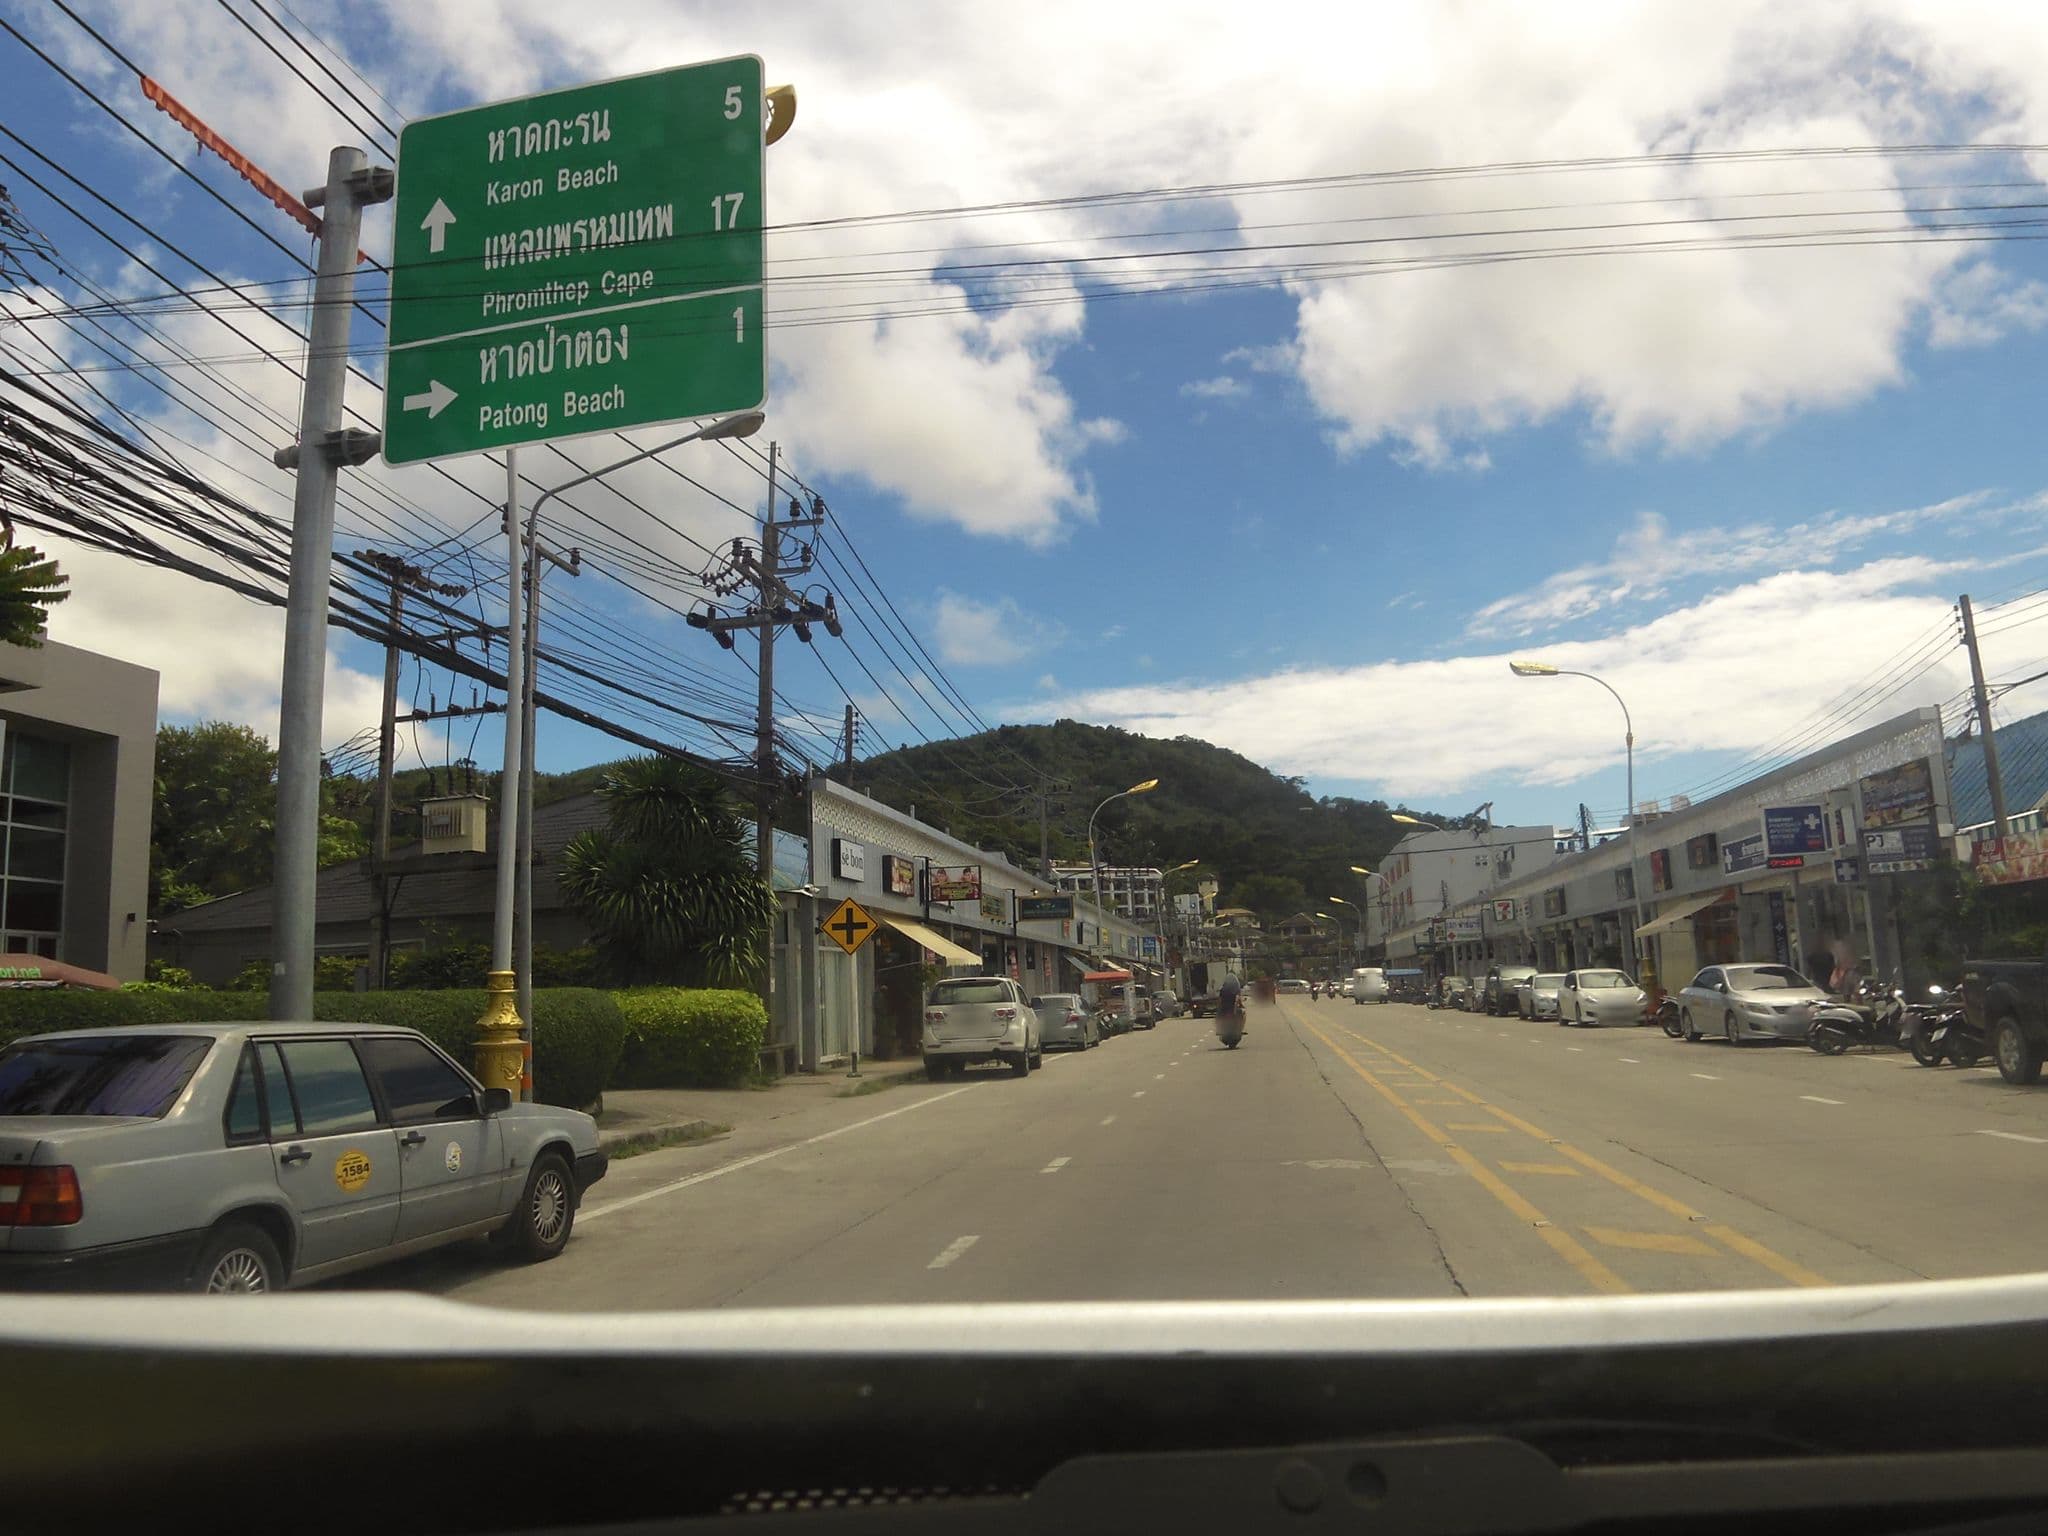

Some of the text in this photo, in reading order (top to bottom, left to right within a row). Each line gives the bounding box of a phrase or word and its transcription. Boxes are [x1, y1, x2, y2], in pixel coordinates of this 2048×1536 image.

[723, 85, 743, 120] 5
[488, 109, 611, 164] หาดกะรน
[487, 160, 618, 206] Karon Beach
[711, 192, 744, 232] 17
[484, 203, 674, 271] แหลมพรหมเทพ
[483, 269, 654, 317] Phromthep Cape
[733, 306, 744, 343] 1
[479, 323, 629, 385] หาดป่าตอง
[479, 384, 625, 432] Patong Beach
[342, 1162, 370, 1178] 1584
